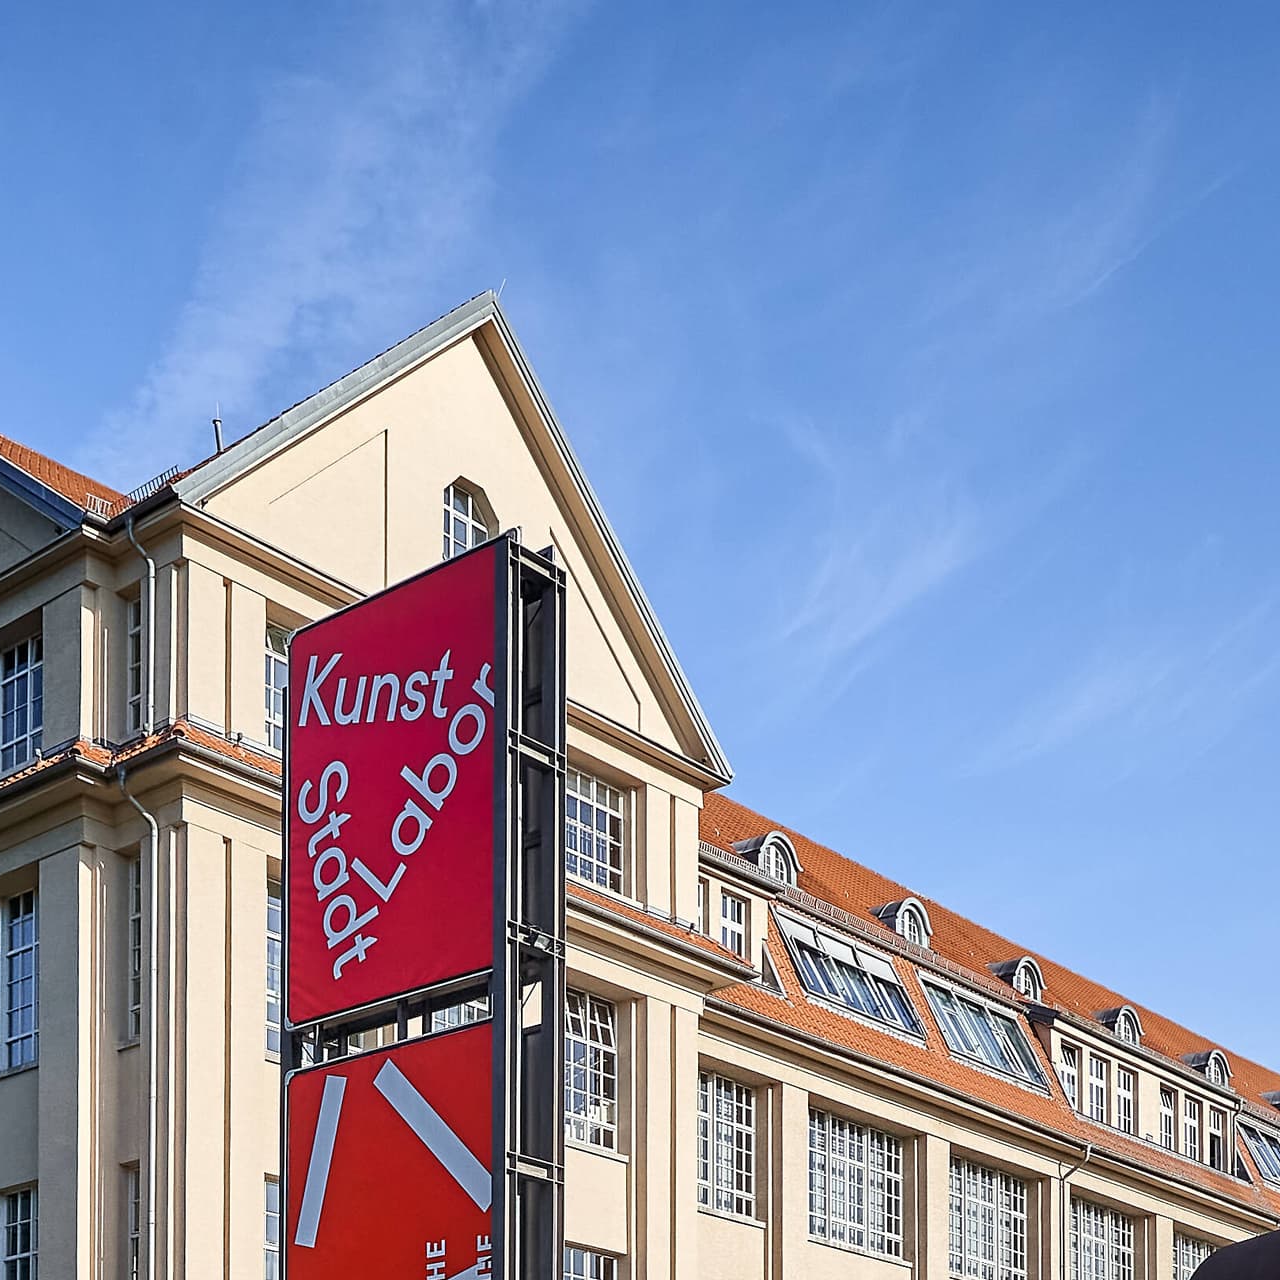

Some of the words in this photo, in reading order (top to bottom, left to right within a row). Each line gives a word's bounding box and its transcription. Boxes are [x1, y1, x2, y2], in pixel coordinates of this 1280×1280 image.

[298, 649, 454, 727] Kunst
[350, 662, 495, 902] Labor
[298, 760, 379, 980] Stadt
